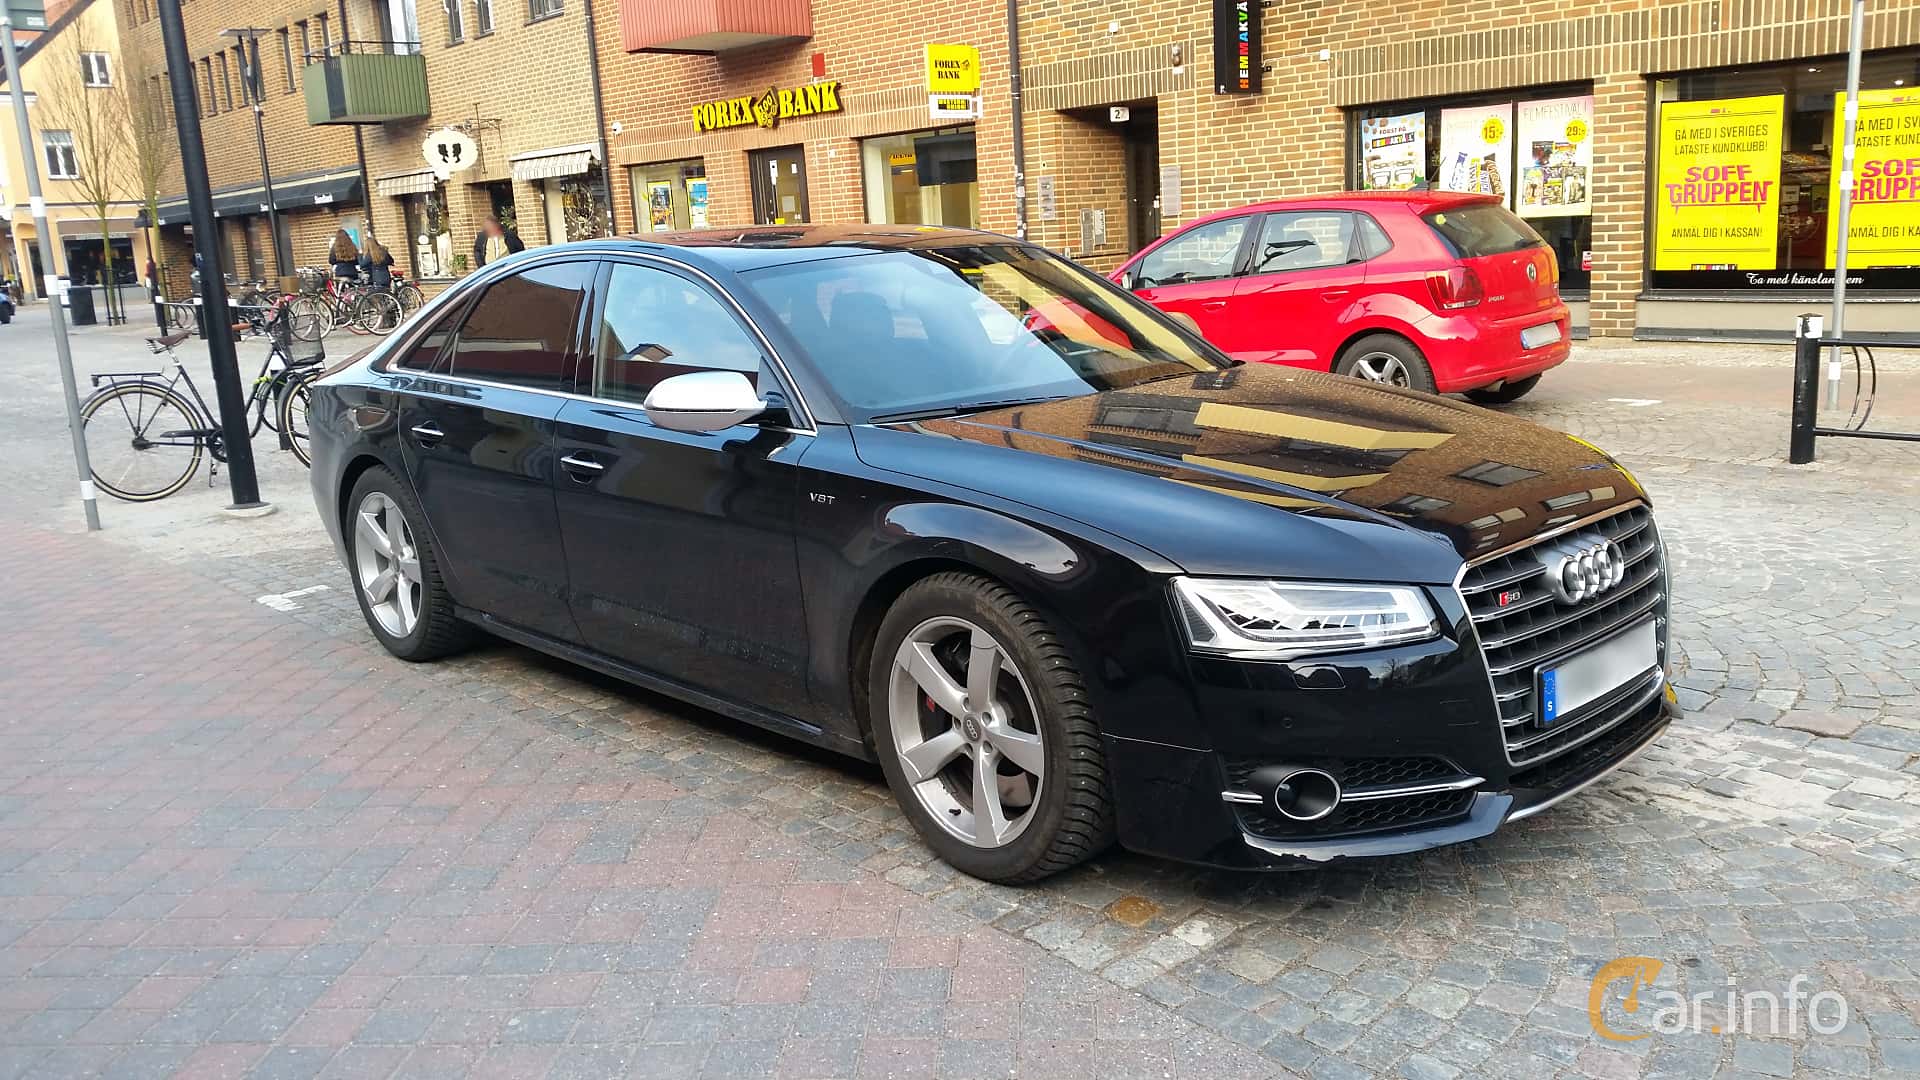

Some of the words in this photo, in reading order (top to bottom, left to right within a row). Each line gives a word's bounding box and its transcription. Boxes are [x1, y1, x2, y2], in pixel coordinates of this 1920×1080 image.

[934, 59, 960, 69] FOREX
[937, 70, 960, 79] BANK
[692, 96, 755, 132] FOREX
[777, 81, 840, 118] BANK
[1114, 109, 1121, 119] 2
[1868, 117, 1893, 131] MED
[1690, 127, 1712, 140] MED
[1720, 124, 1769, 138] SVERIGES
[1712, 139, 1768, 153] KUNDKLUBB!
[1855, 135, 1892, 148] ATASTE
[1684, 164, 1753, 183] SOFF
[1665, 180, 1773, 204] GRUPPEN
[1703, 227, 1718, 238] DIG
[1725, 226, 1763, 238] KASSAN!
[1882, 226, 1900, 238] DIG
[1746, 272, 1764, 285] Ta
[1766, 273, 1789, 285] med
[1547, 700, 1553, 712] S
